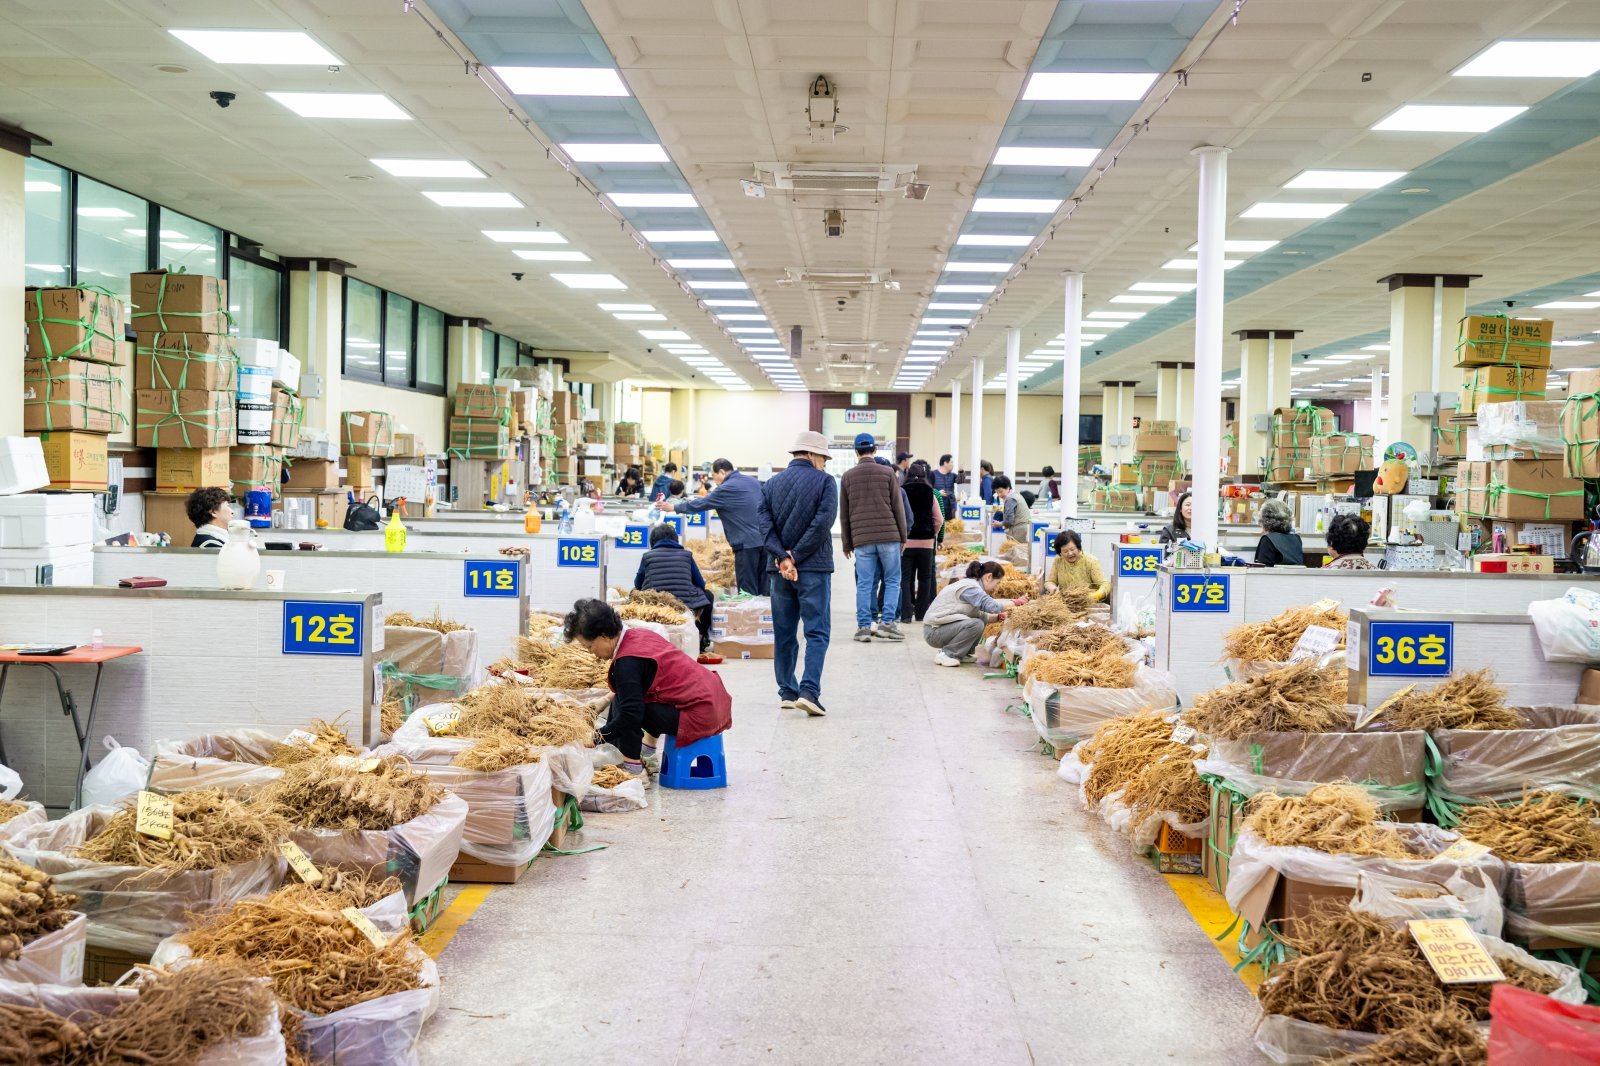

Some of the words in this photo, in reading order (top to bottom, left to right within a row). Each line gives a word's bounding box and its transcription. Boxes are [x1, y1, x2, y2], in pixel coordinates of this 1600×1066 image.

[1480, 322, 1497, 335] 인삼
[1525, 326, 1541, 338] 박스
[962, 510, 980, 519] 43호
[622, 530, 643, 545] 9호
[561, 544, 596, 563] 10호
[1122, 554, 1161, 572] 38호
[469, 569, 515, 591] 11호
[1177, 582, 1226, 604] 37호
[290, 613, 356, 645] 12호
[1376, 634, 1447, 665] 36호
